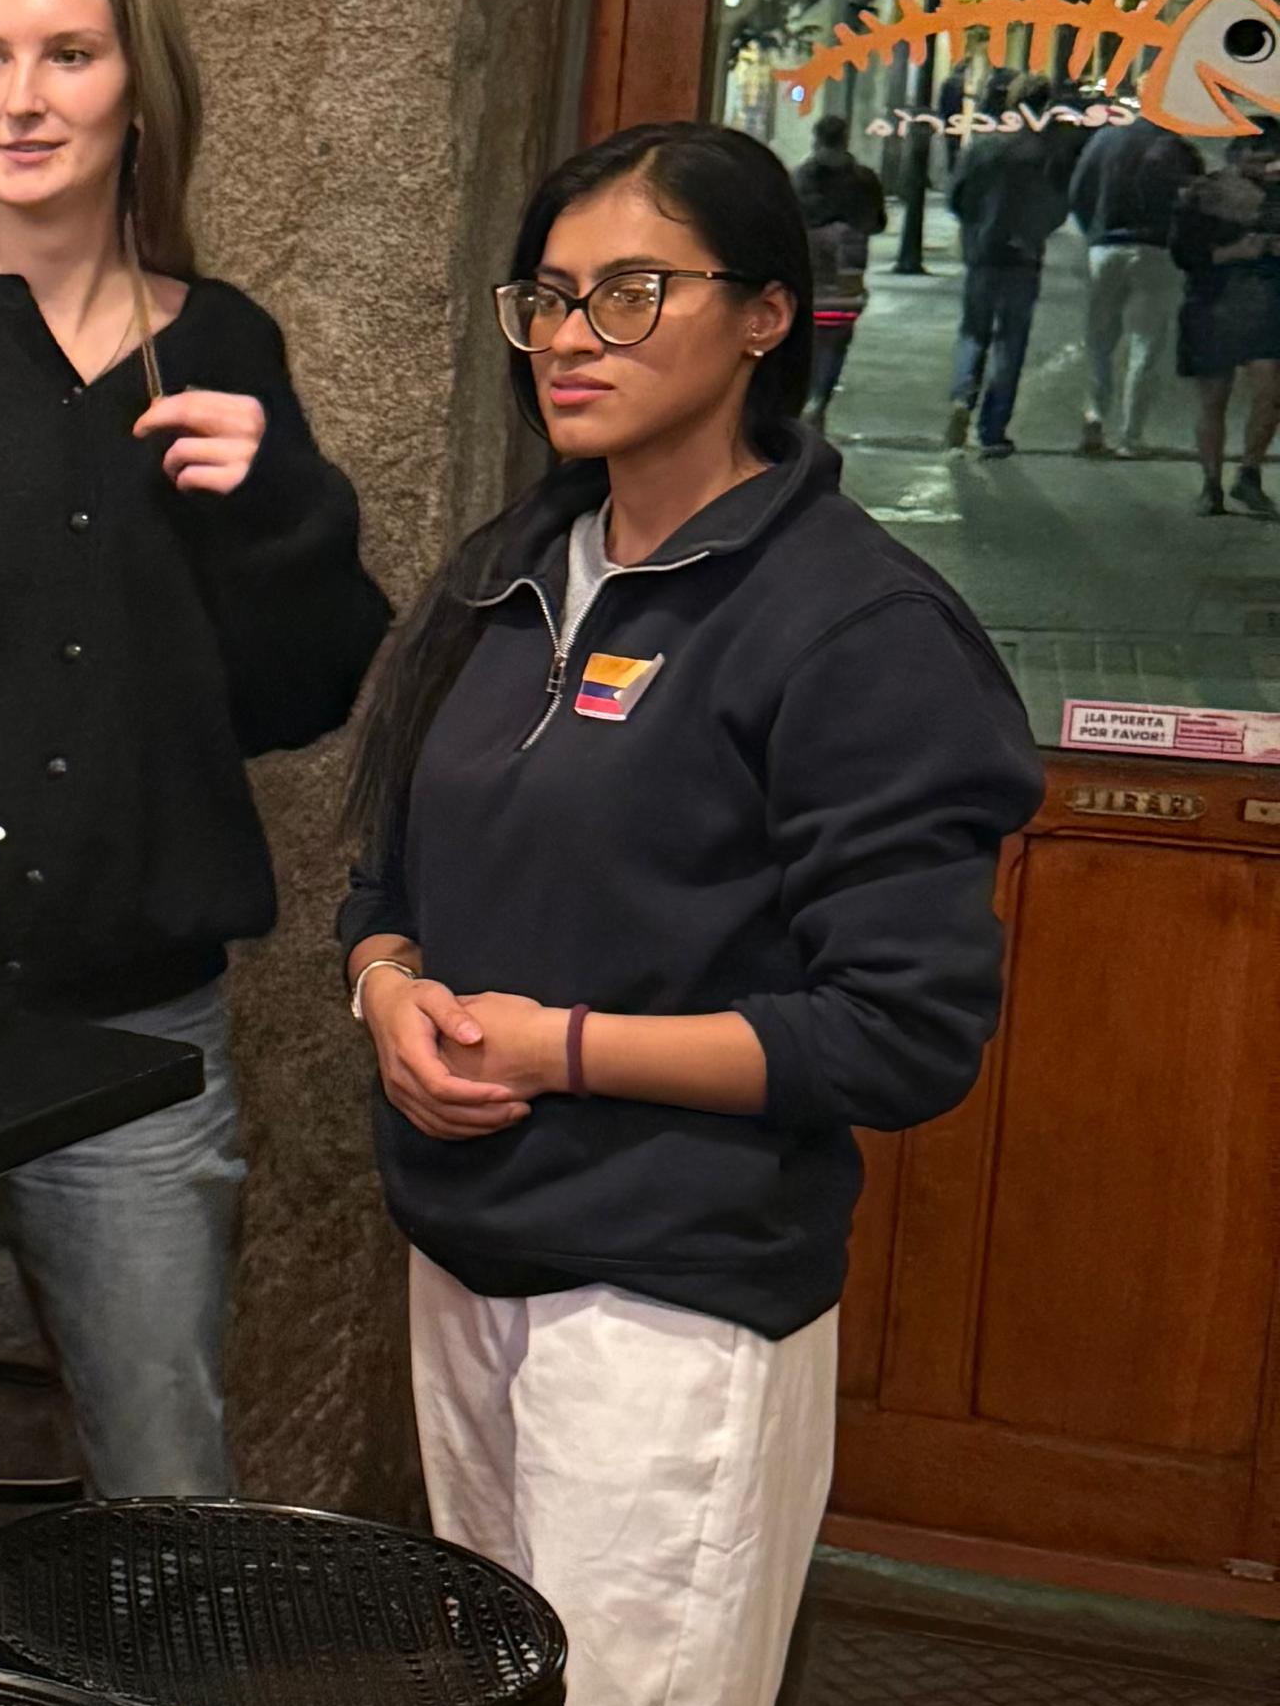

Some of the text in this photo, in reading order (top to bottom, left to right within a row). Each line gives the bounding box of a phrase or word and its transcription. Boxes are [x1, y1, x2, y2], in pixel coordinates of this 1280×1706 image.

[1110, 714, 1164, 727] PUERTA
[1079, 726, 1107, 738] POR
[1112, 728, 1165, 742] FAVOR!
